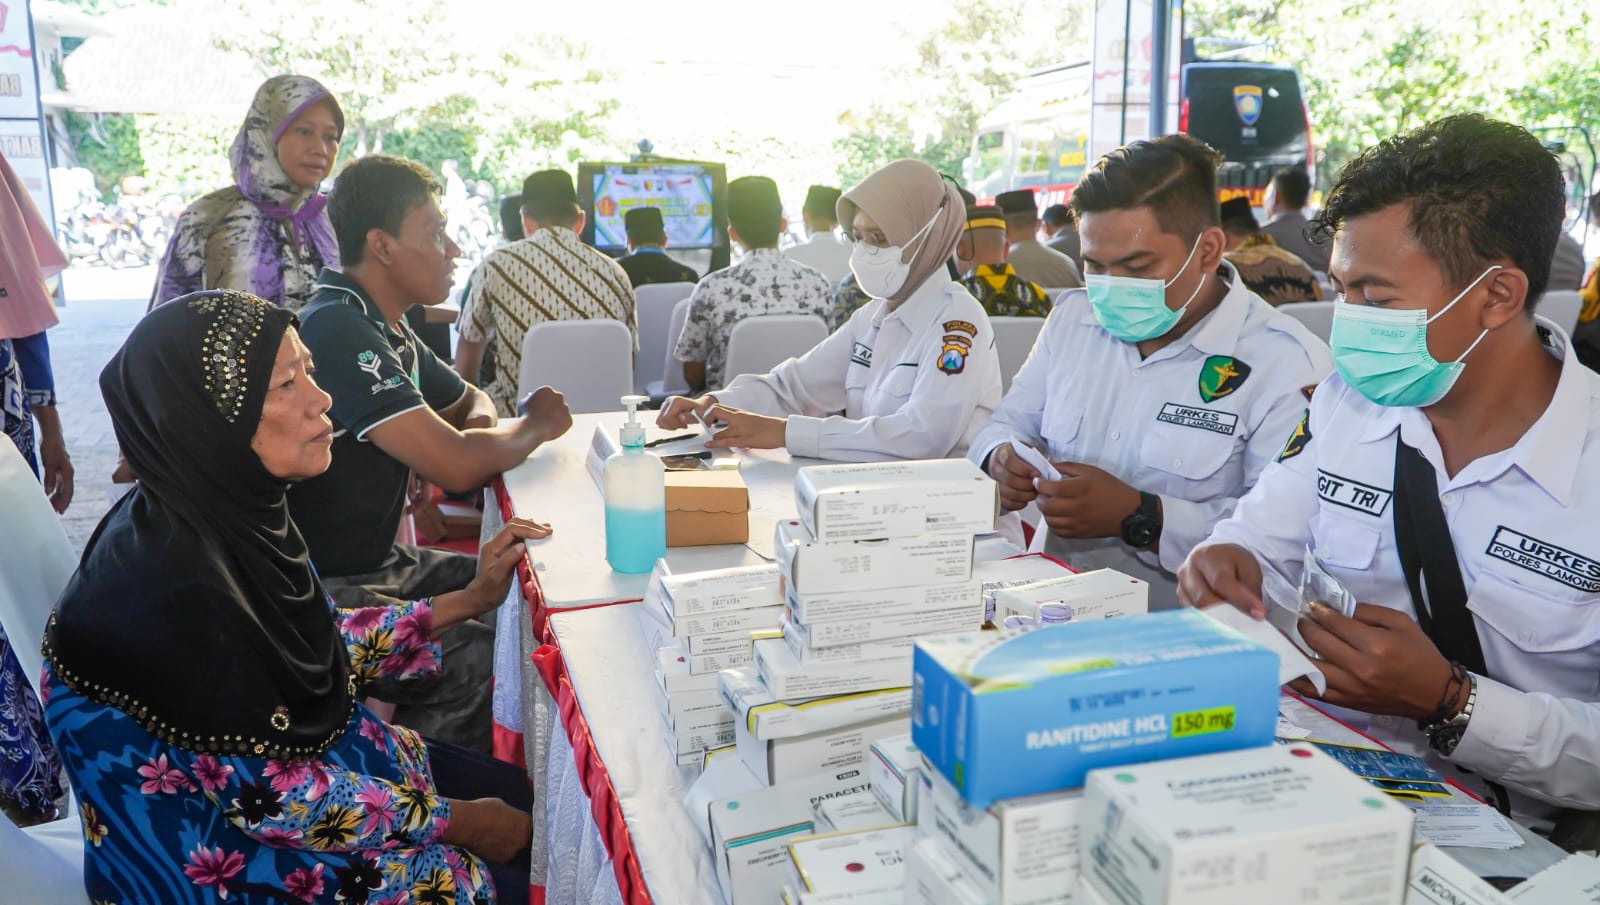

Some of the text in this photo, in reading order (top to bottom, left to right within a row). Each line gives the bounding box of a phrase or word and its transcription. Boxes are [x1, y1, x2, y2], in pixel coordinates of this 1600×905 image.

[1161, 414, 1230, 433] POLRES LAMONGAN
[1175, 407, 1220, 422] URKES
[1351, 487, 1380, 509] TRI
[1493, 546, 1541, 569] POLRES
[1519, 538, 1600, 577] URKES
[1025, 712, 1234, 750] RANITIDINE HCL 150 mg
[1420, 875, 1466, 905] MICON
